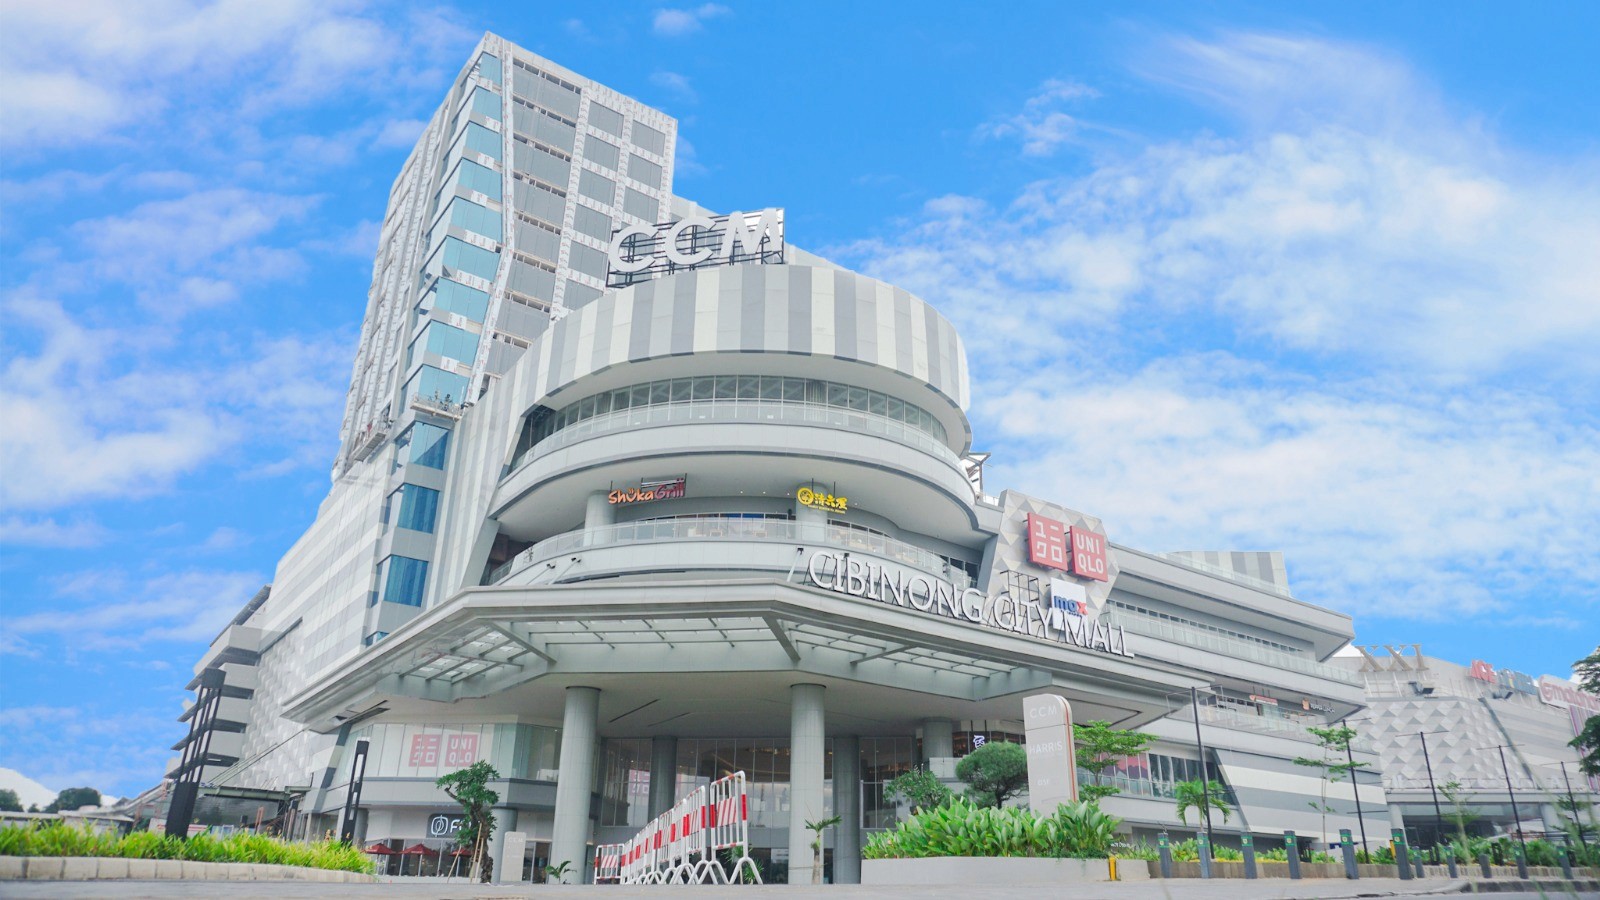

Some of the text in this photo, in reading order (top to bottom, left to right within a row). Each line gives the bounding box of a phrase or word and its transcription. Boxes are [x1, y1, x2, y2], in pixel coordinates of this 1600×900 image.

[608, 208, 782, 272] CCM
[1075, 532, 1100, 554] UNI
[1077, 553, 1104, 575] QLO
[808, 550, 1135, 658] CIBINONG CITY MALL
[1053, 596, 1088, 615] max
[1354, 644, 1430, 672] XXI
[1471, 660, 1497, 684] ACE
[1030, 705, 1057, 718] CCM
[451, 738, 473, 750] UNI
[1029, 740, 1063, 755] HARRIS
[449, 751, 472, 764] QLO
